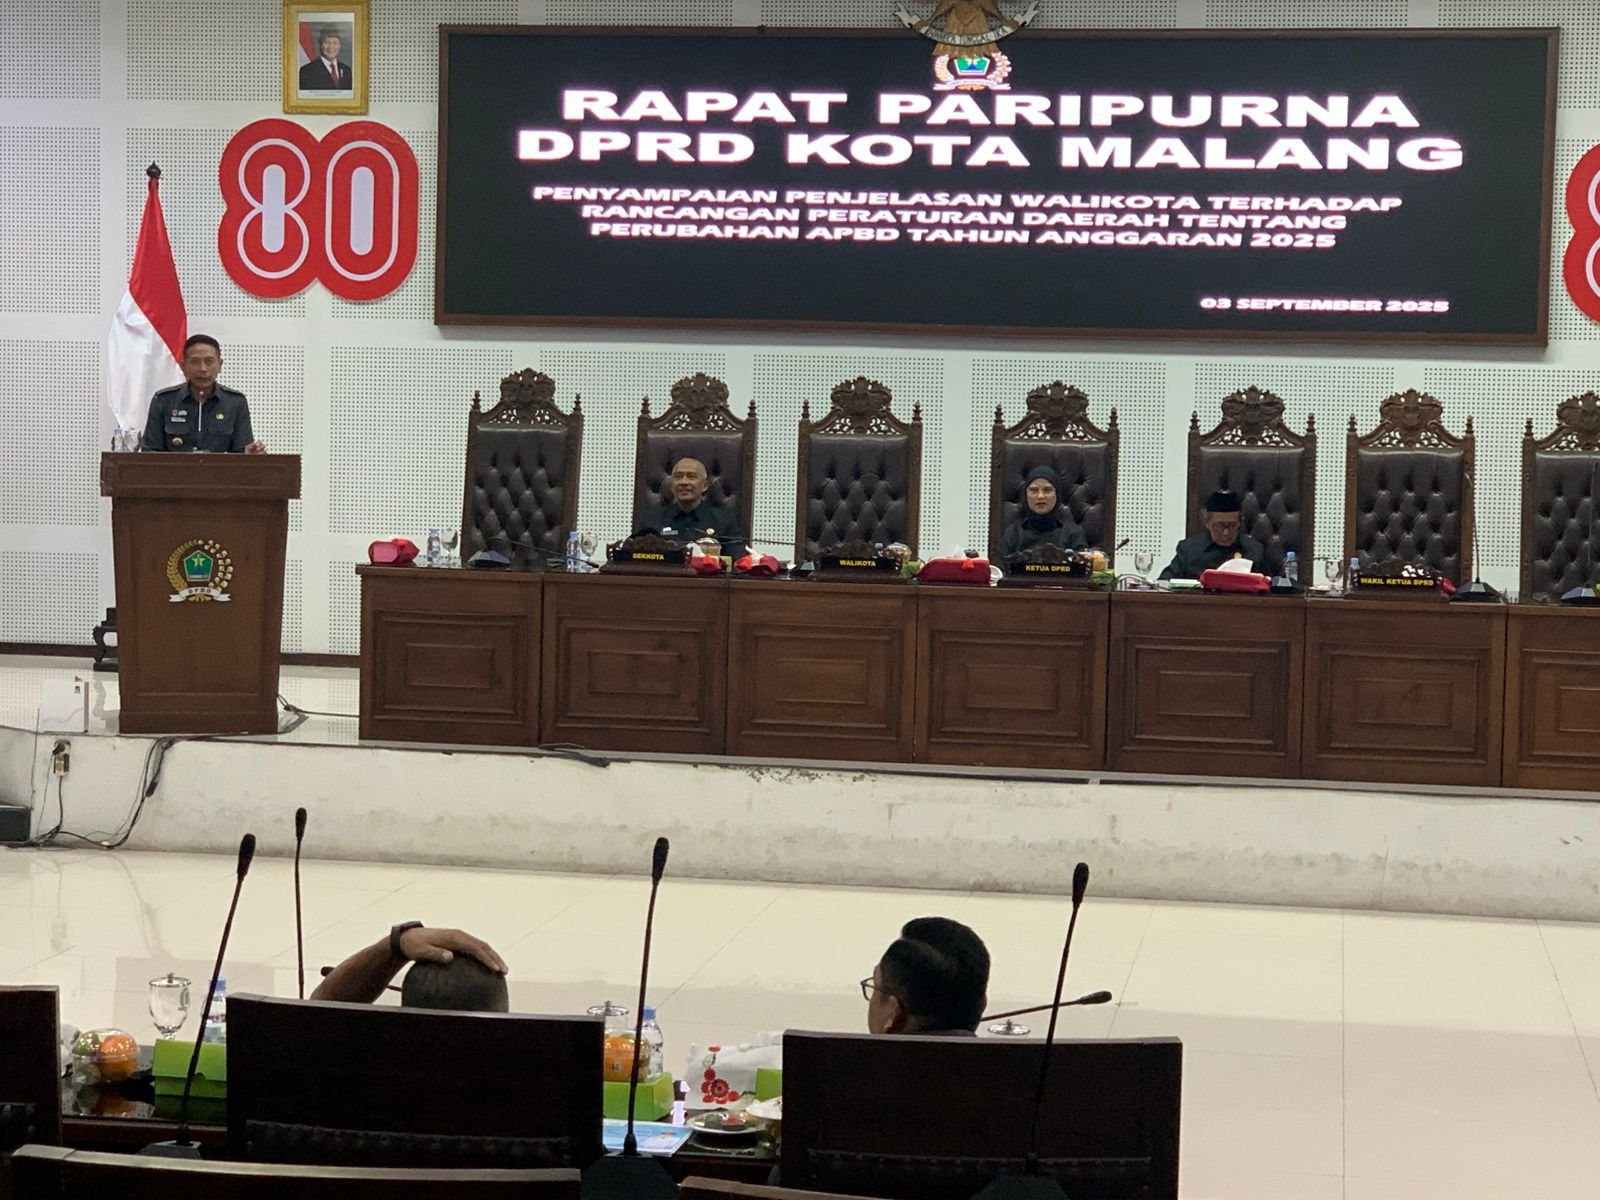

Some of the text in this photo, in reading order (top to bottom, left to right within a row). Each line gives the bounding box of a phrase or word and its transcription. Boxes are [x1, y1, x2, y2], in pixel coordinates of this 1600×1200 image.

[562, 90, 1421, 128] RAPAT PARIPURNA
[517, 130, 1464, 171] DPRD KOTA MALANG
[218, 118, 420, 300] 80
[532, 186, 1403, 212] PENYAMPAIAN PENJELASAN WALIKOTA TERHADAP
[581, 204, 1347, 230] RANCANGAN PERATURAN DAERAH TENTANG
[590, 222, 1337, 248] PERUBAHAN APBD TAHUN ANGGARAN 2025
[1199, 297, 1450, 313] 03 SEPTEMBER 2025
[839, 559, 877, 567] WALIKOTA
[1025, 564, 1050, 572] KETUA
[1360, 577, 1384, 585] WAKIL
